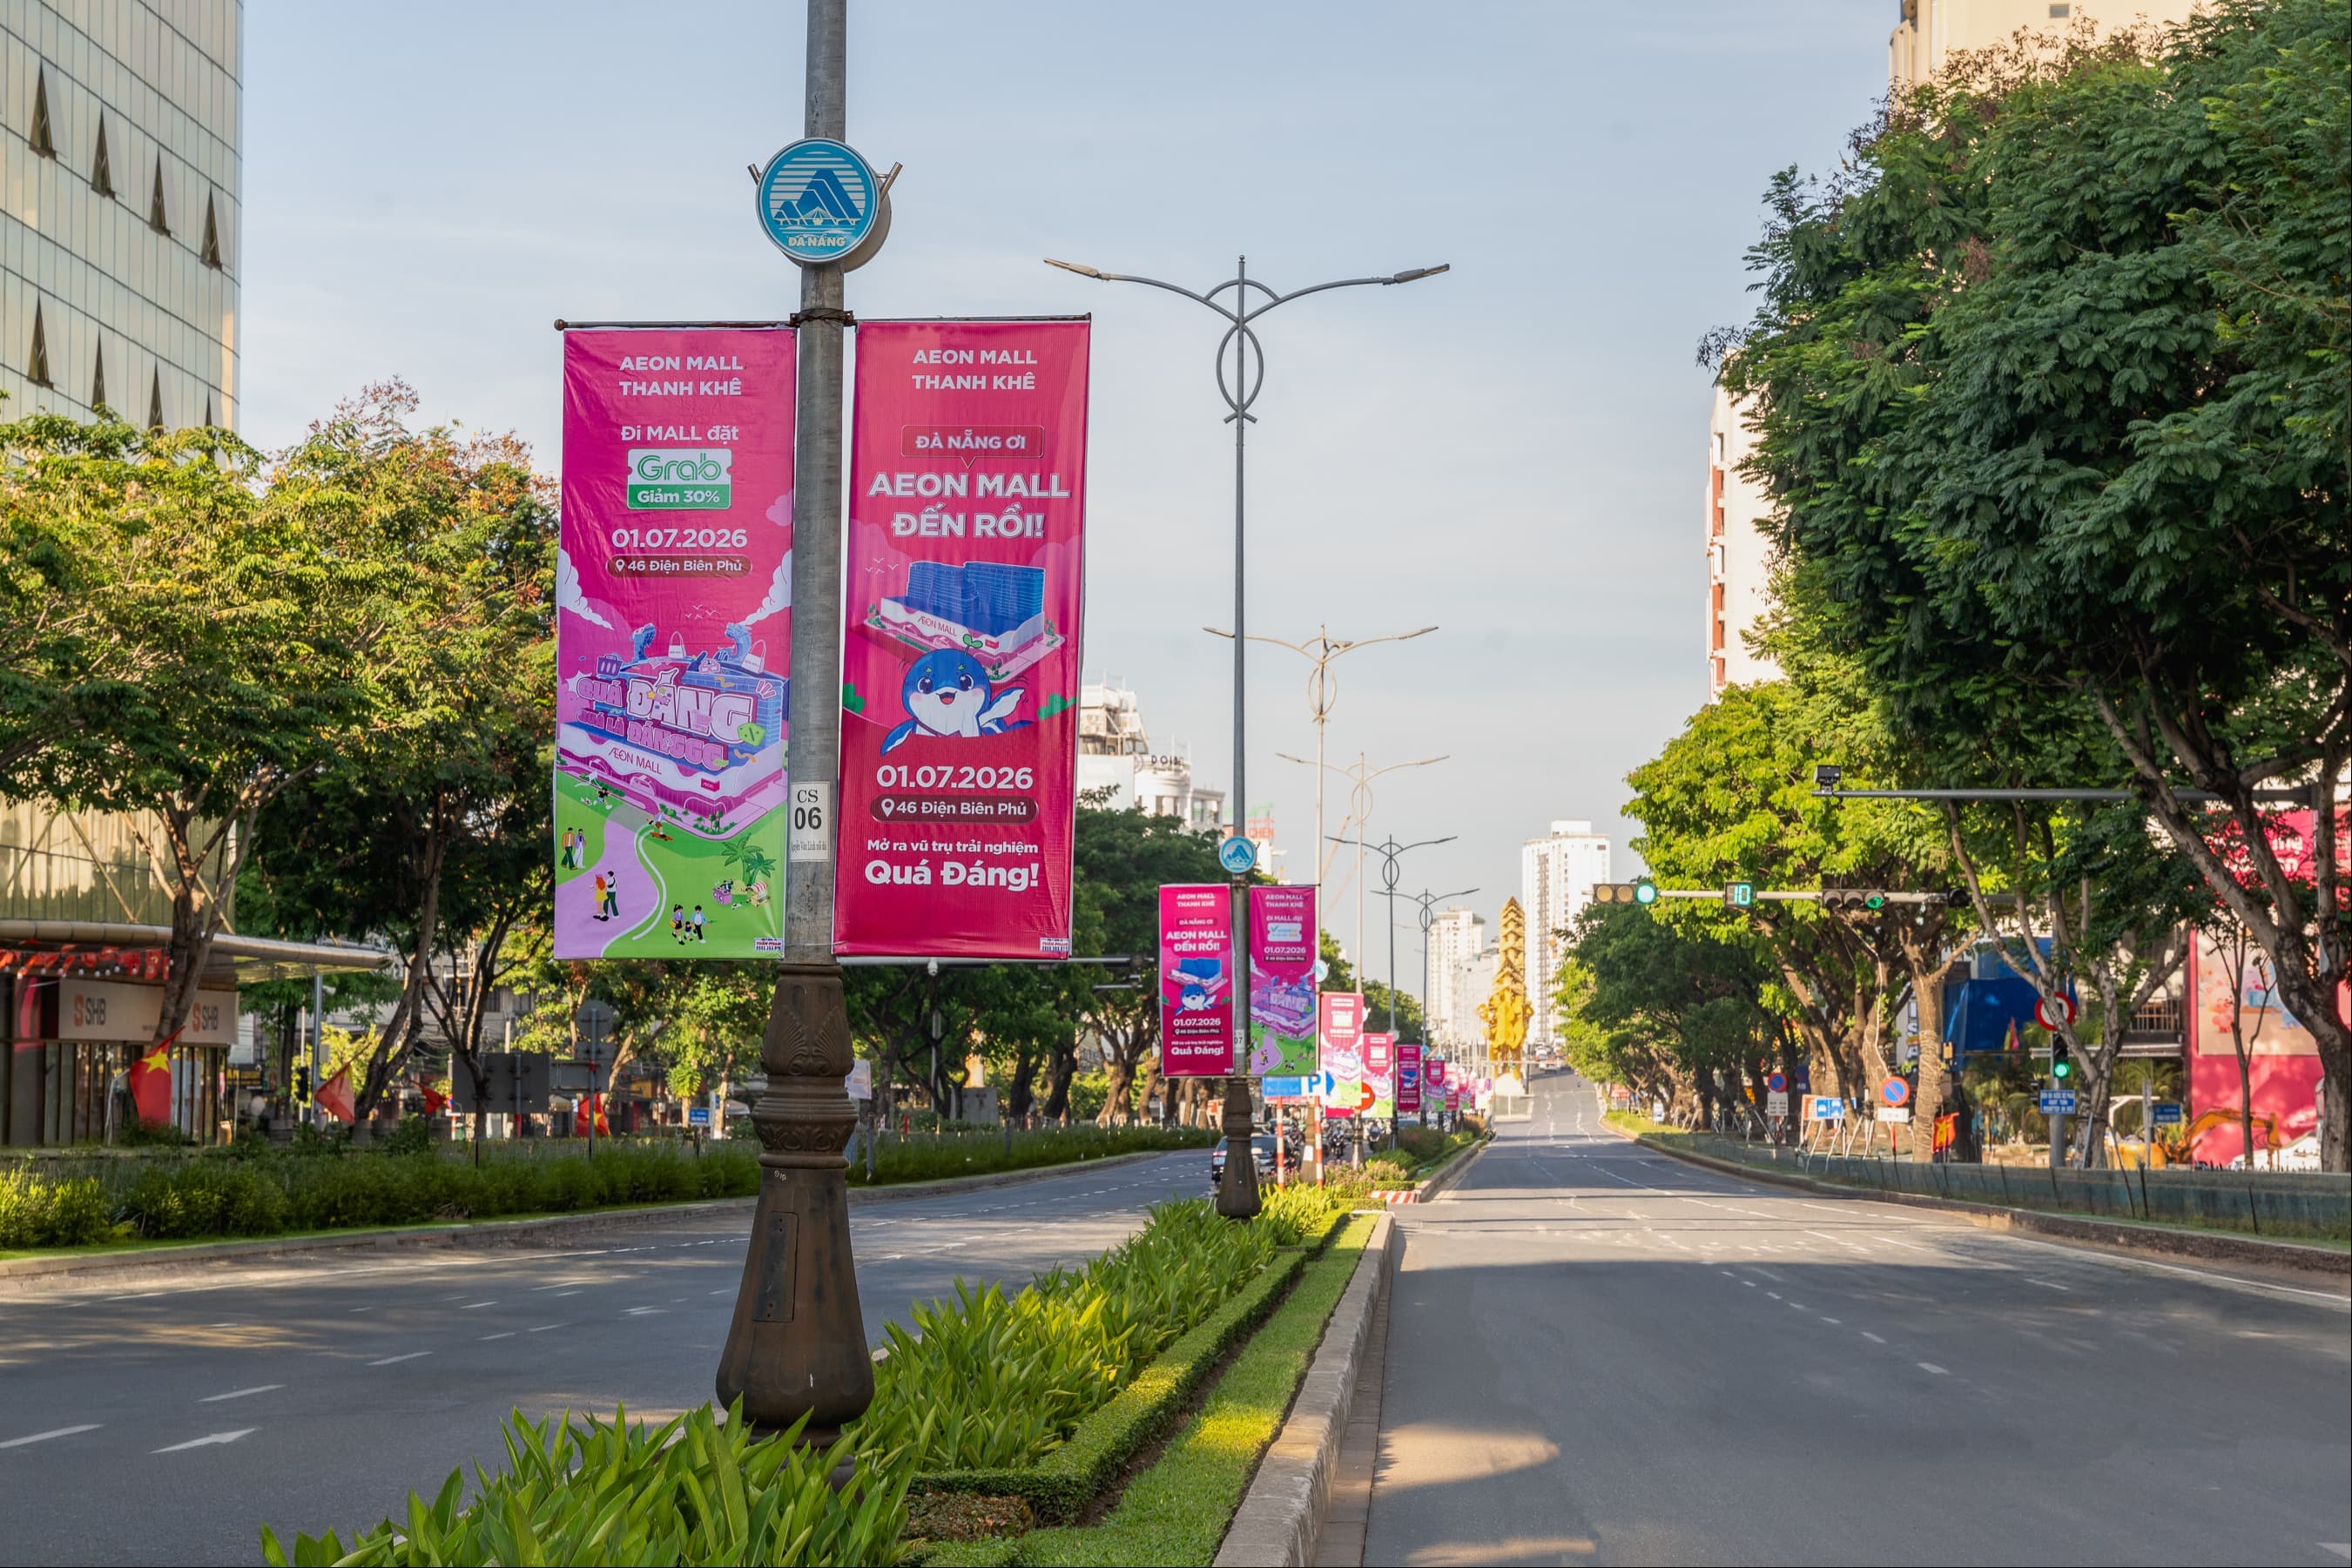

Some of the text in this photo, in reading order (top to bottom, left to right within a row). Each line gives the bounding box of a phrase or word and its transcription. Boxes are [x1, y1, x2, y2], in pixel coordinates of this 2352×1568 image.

[619, 356, 744, 371] AEON MALL
[913, 350, 1037, 364] AEON MALL
[619, 378, 742, 395] THANH KHÊ
[912, 372, 1035, 390] THANH KHÊ
[621, 426, 738, 444] Đi MALL đặt
[916, 429, 1026, 449] ĐÀ NẴNG ƠI
[637, 453, 721, 481] Grab
[637, 488, 720, 502] Giảm 30%
[867, 473, 1070, 498] AEON MALL
[892, 501, 1045, 538] ĐẾN RỒI!
[611, 528, 747, 548] 01.07.2026
[627, 559, 742, 574] 46 Điện Biên Phủ
[938, 622, 957, 636] MALL
[636, 757, 662, 775] MALL
[876, 764, 1034, 790] 01.07.2026
[798, 790, 819, 803] CS
[896, 799, 1027, 818] 46 Điện Biên Phủ
[795, 807, 822, 830] 06
[867, 839, 1038, 856] Mở ra vũ trụ trải nghiệm
[865, 858, 1040, 892] Quá Đáng!
[1735, 885, 1750, 905] 10
[85, 998, 106, 1026] SHB
[202, 1006, 219, 1031] SHB
[1171, 1046, 1224, 1055] Quá Đáng!
[1308, 1073, 1321, 1094] P
